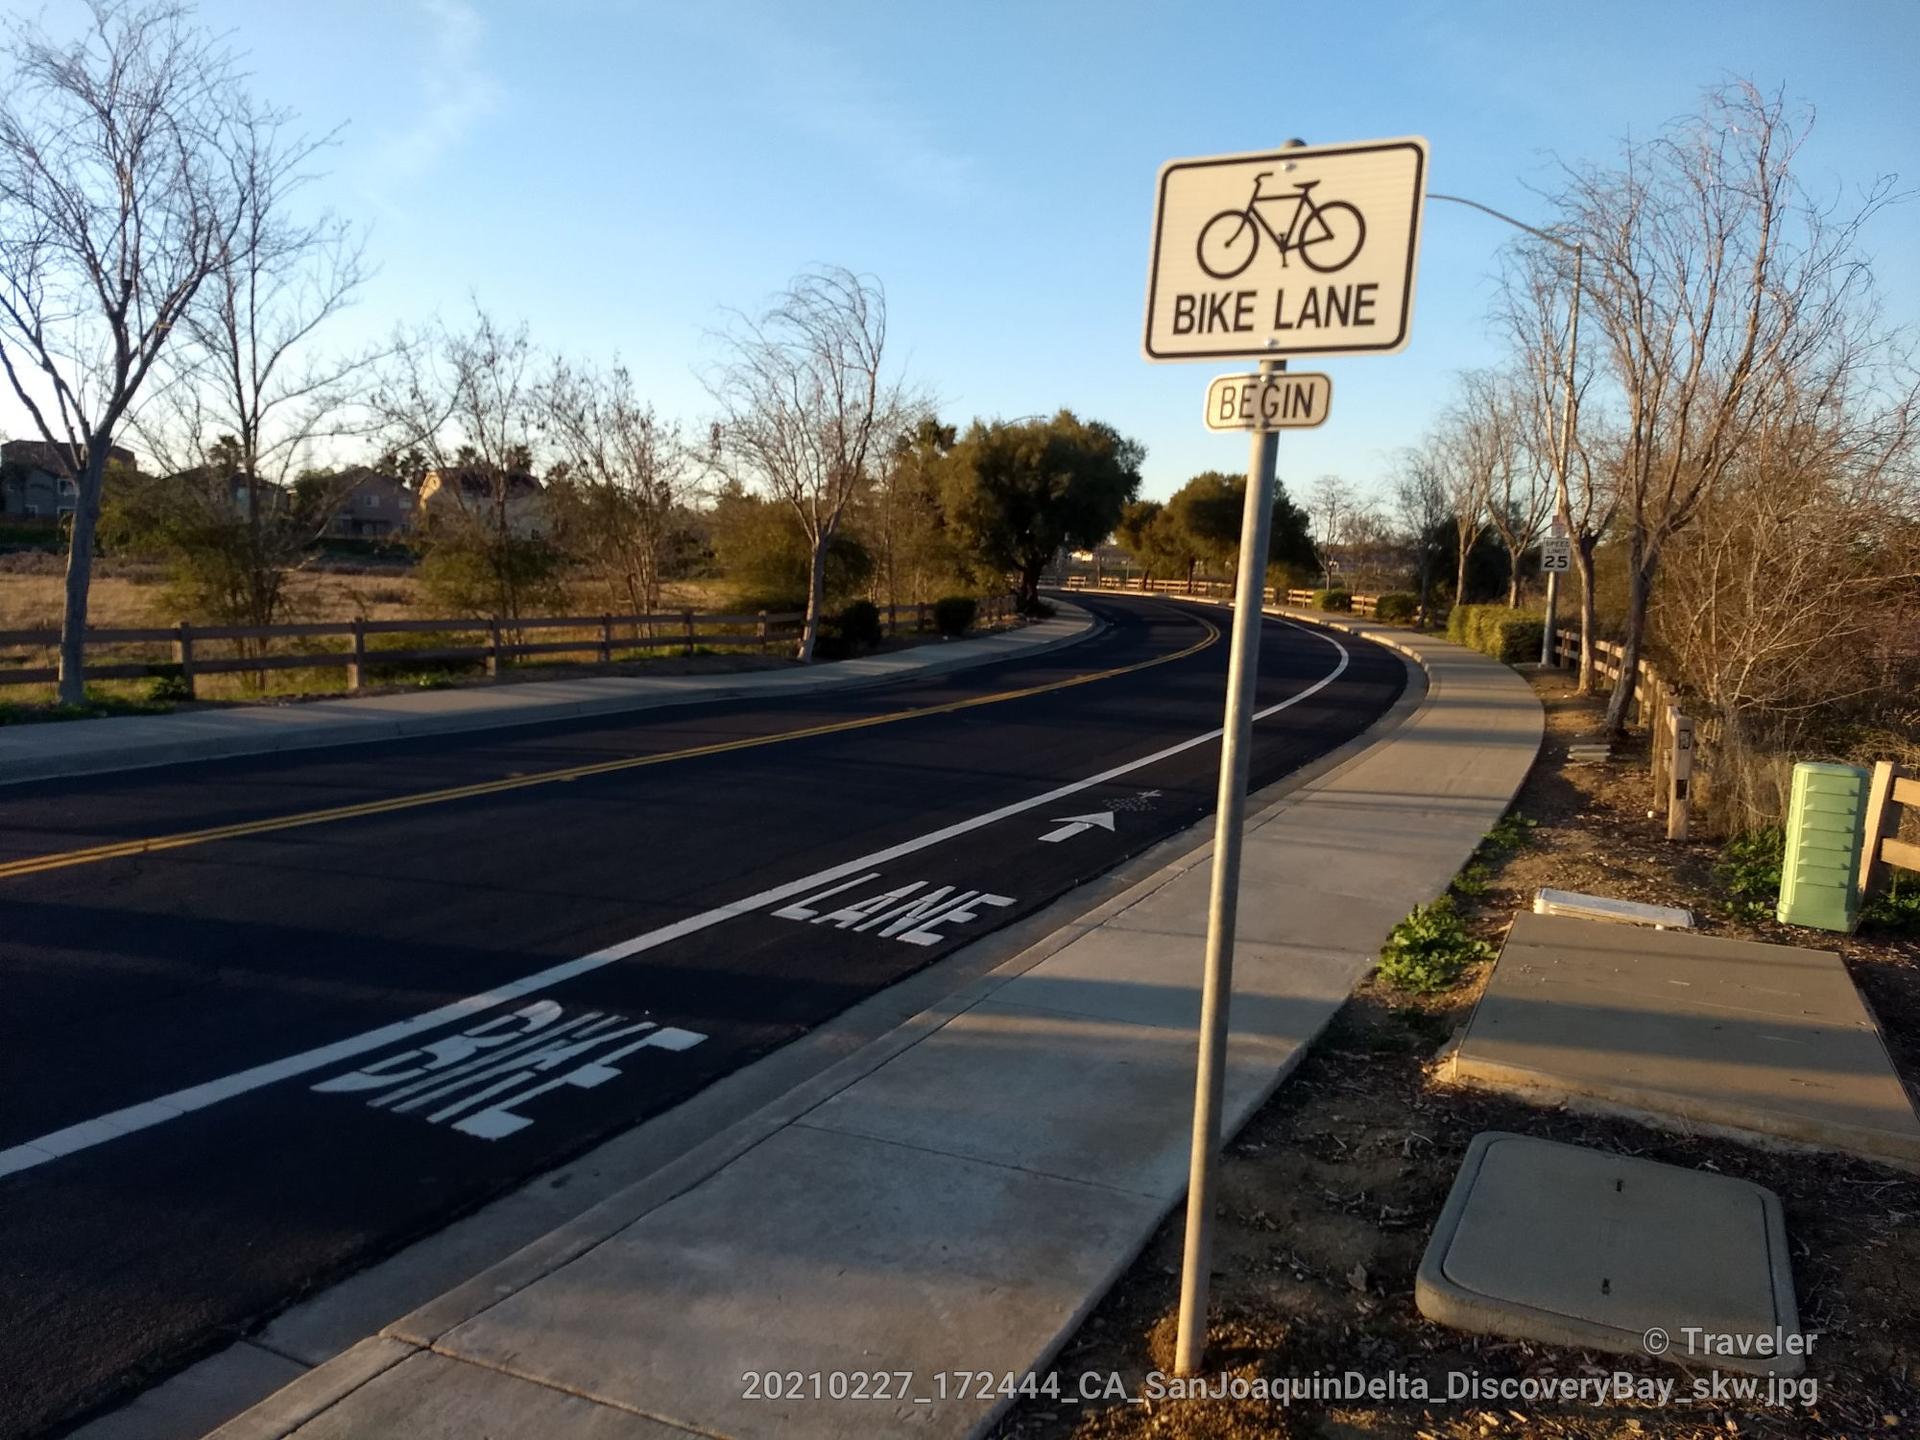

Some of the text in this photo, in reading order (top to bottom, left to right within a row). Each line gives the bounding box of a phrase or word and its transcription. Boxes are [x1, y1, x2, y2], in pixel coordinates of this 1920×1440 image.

[1172, 283, 1379, 335] BIKE LANE
[1219, 383, 1316, 421] BEGIN
[1543, 555, 1568, 568] 25
[770, 872, 1018, 946] LANE
[310, 999, 709, 1140] BIKE
